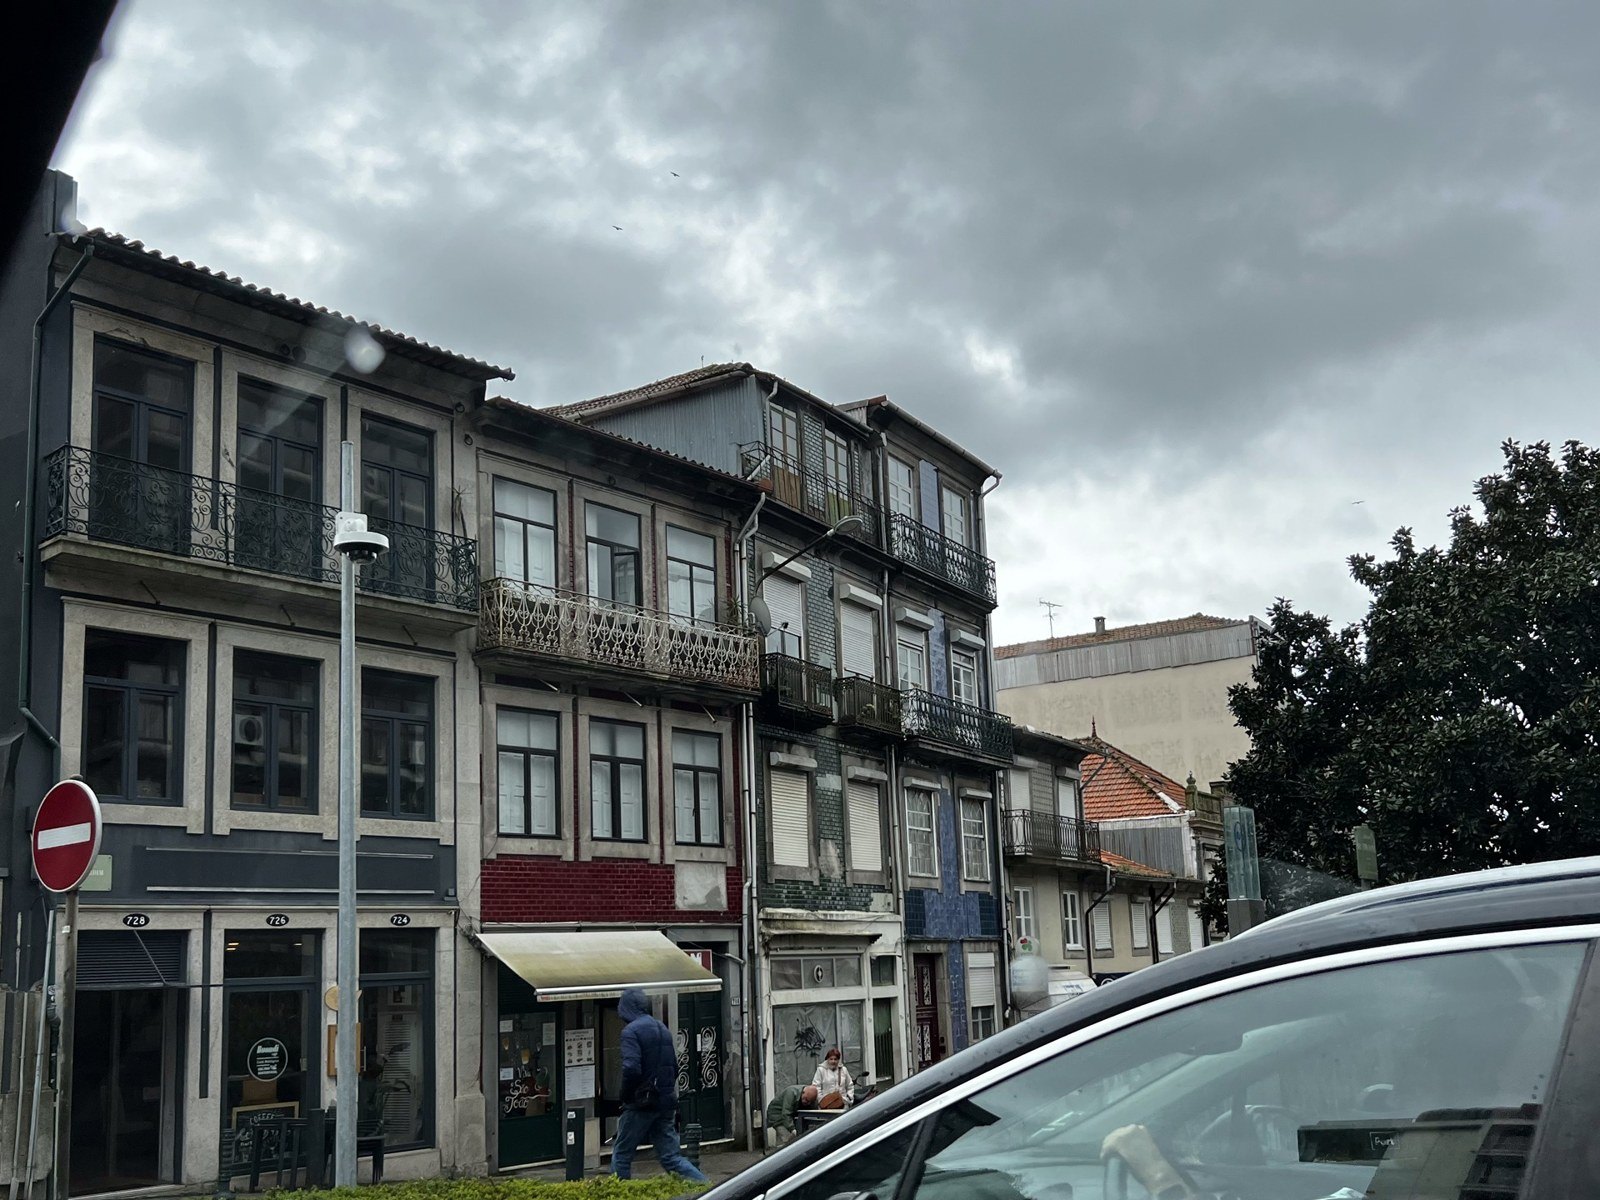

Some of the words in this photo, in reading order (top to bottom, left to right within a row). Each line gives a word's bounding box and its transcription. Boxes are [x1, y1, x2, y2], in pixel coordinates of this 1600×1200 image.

[126, 916, 146, 925] 728
[269, 916, 286, 925] 726
[392, 916, 408, 924] 724
